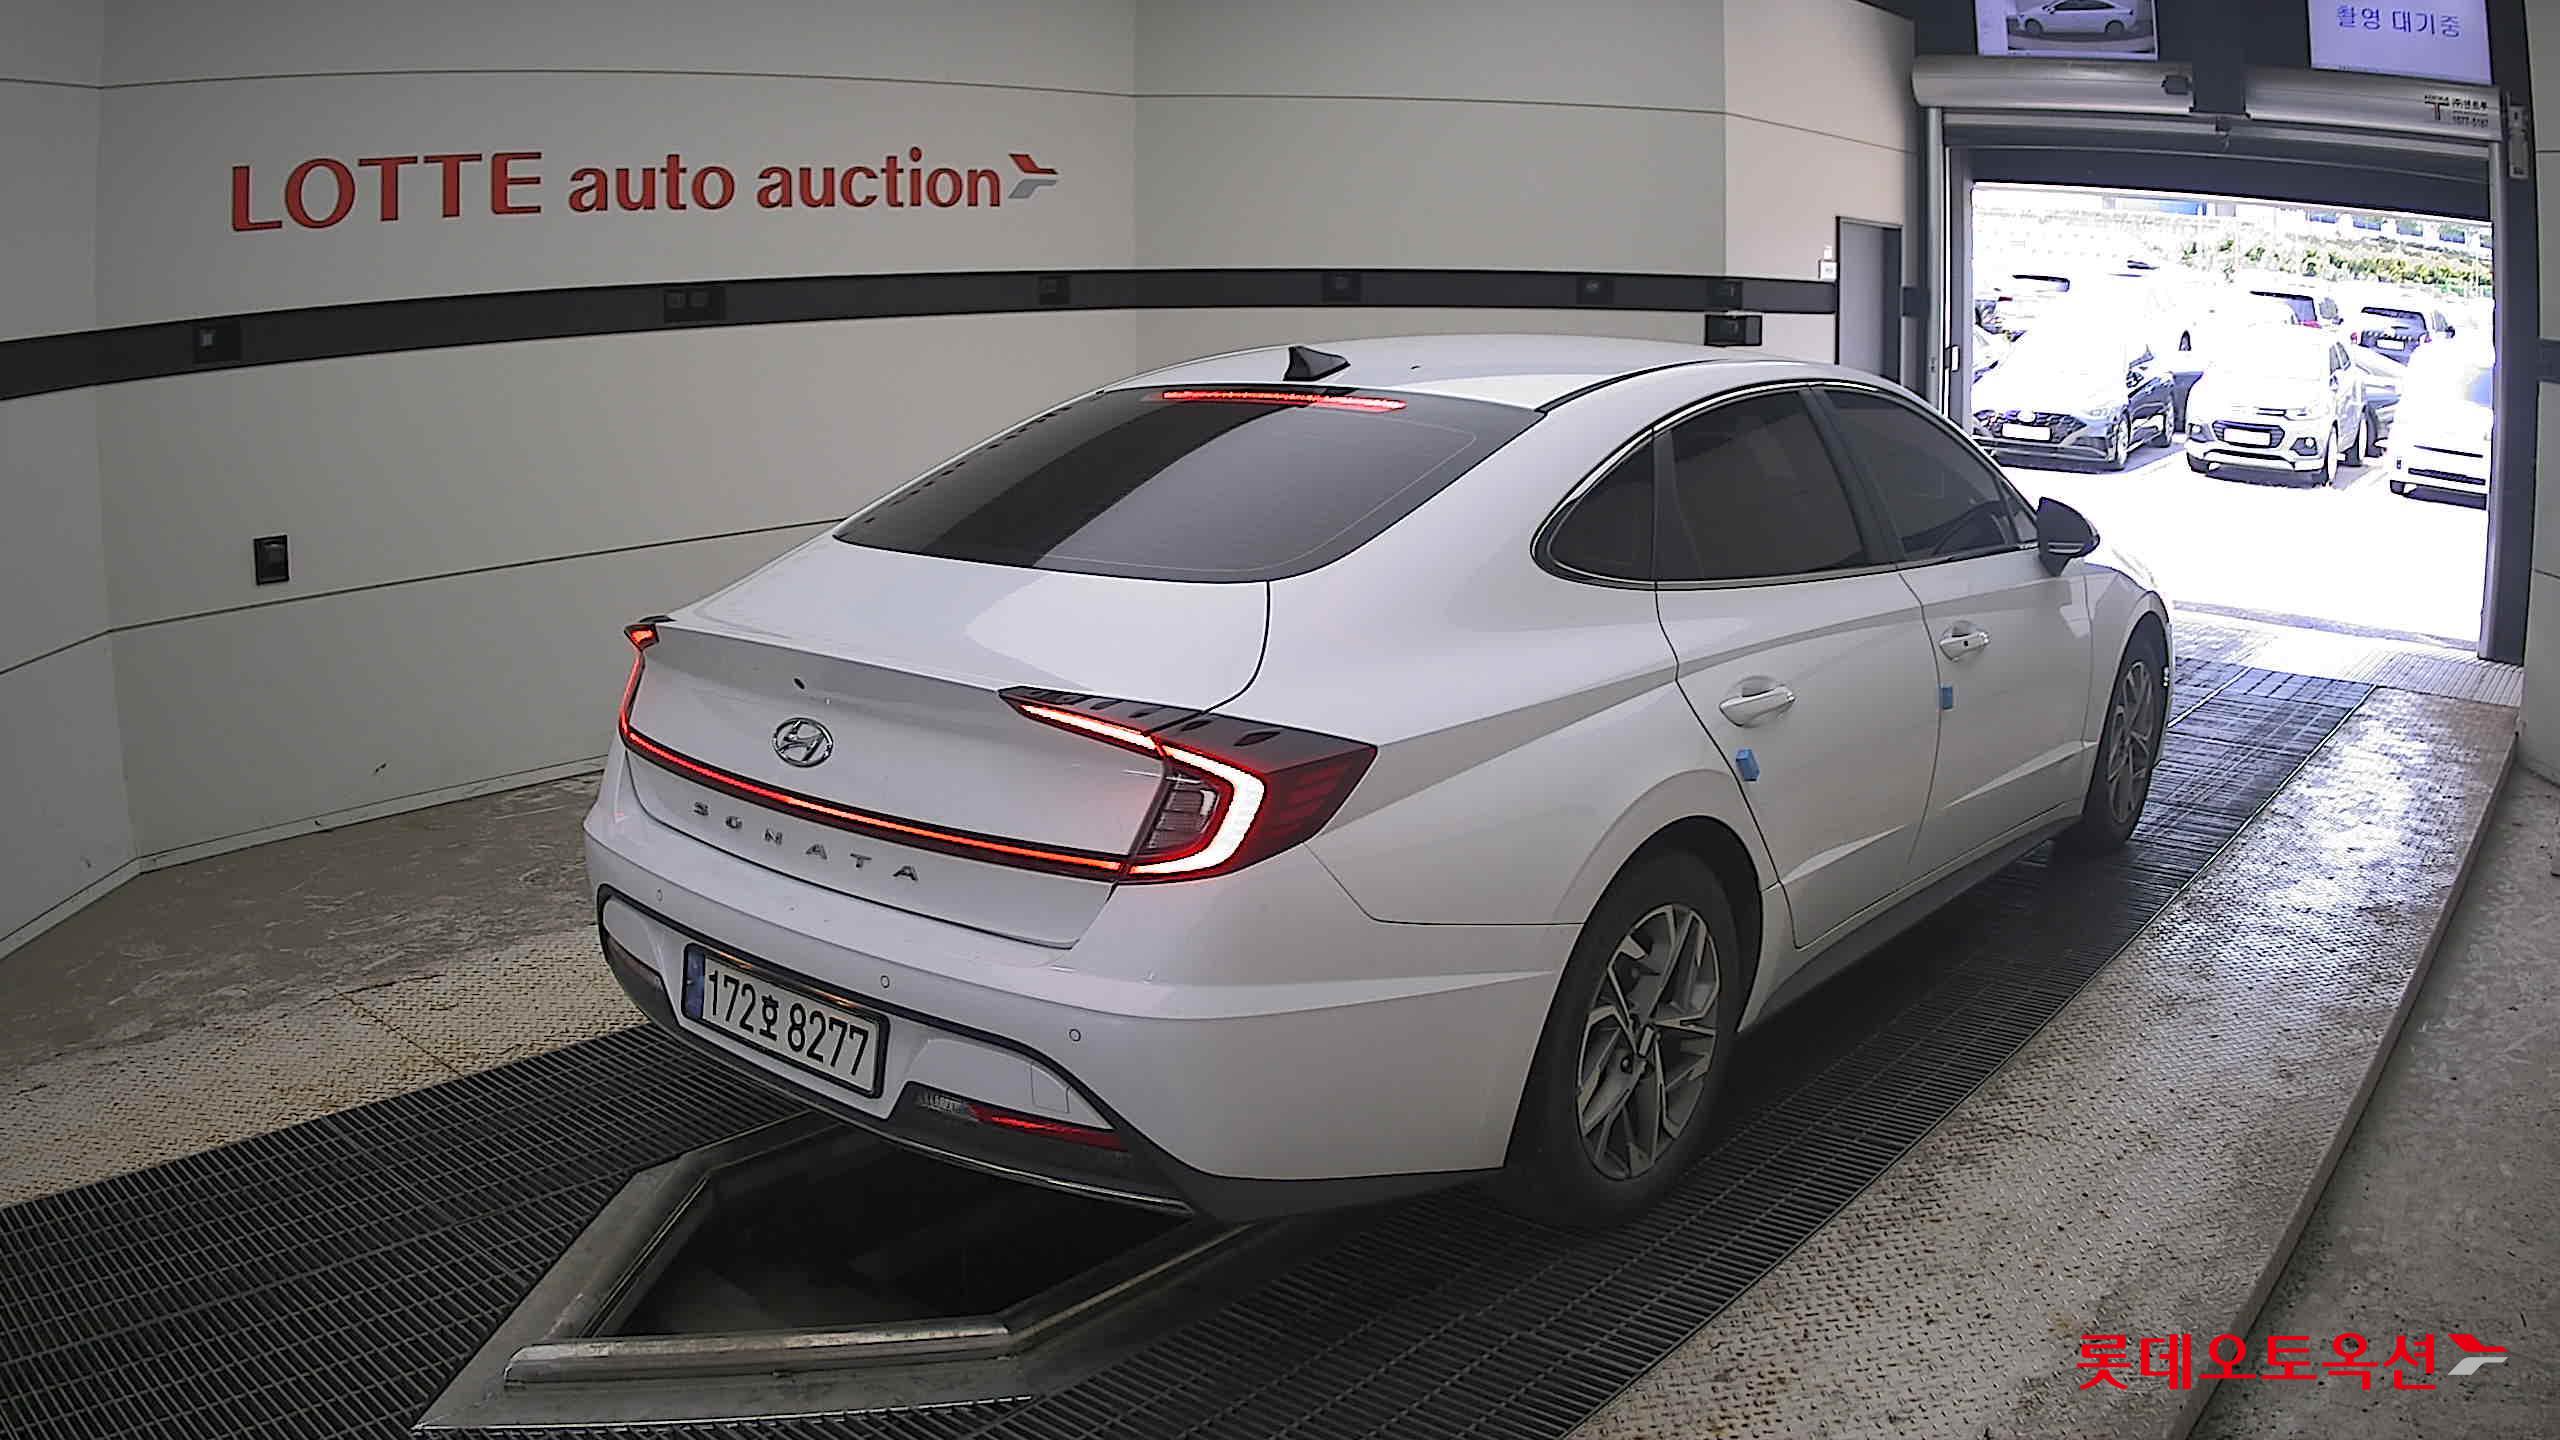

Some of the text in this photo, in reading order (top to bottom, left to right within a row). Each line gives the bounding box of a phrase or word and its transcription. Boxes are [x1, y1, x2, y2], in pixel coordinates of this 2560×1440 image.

[2337, 4, 2461, 38] 촬영 대기중
[231, 146, 1001, 232] LOTTE auto auction
[693, 801, 919, 881] SONATA
[708, 970, 869, 1076] 172호 8277
